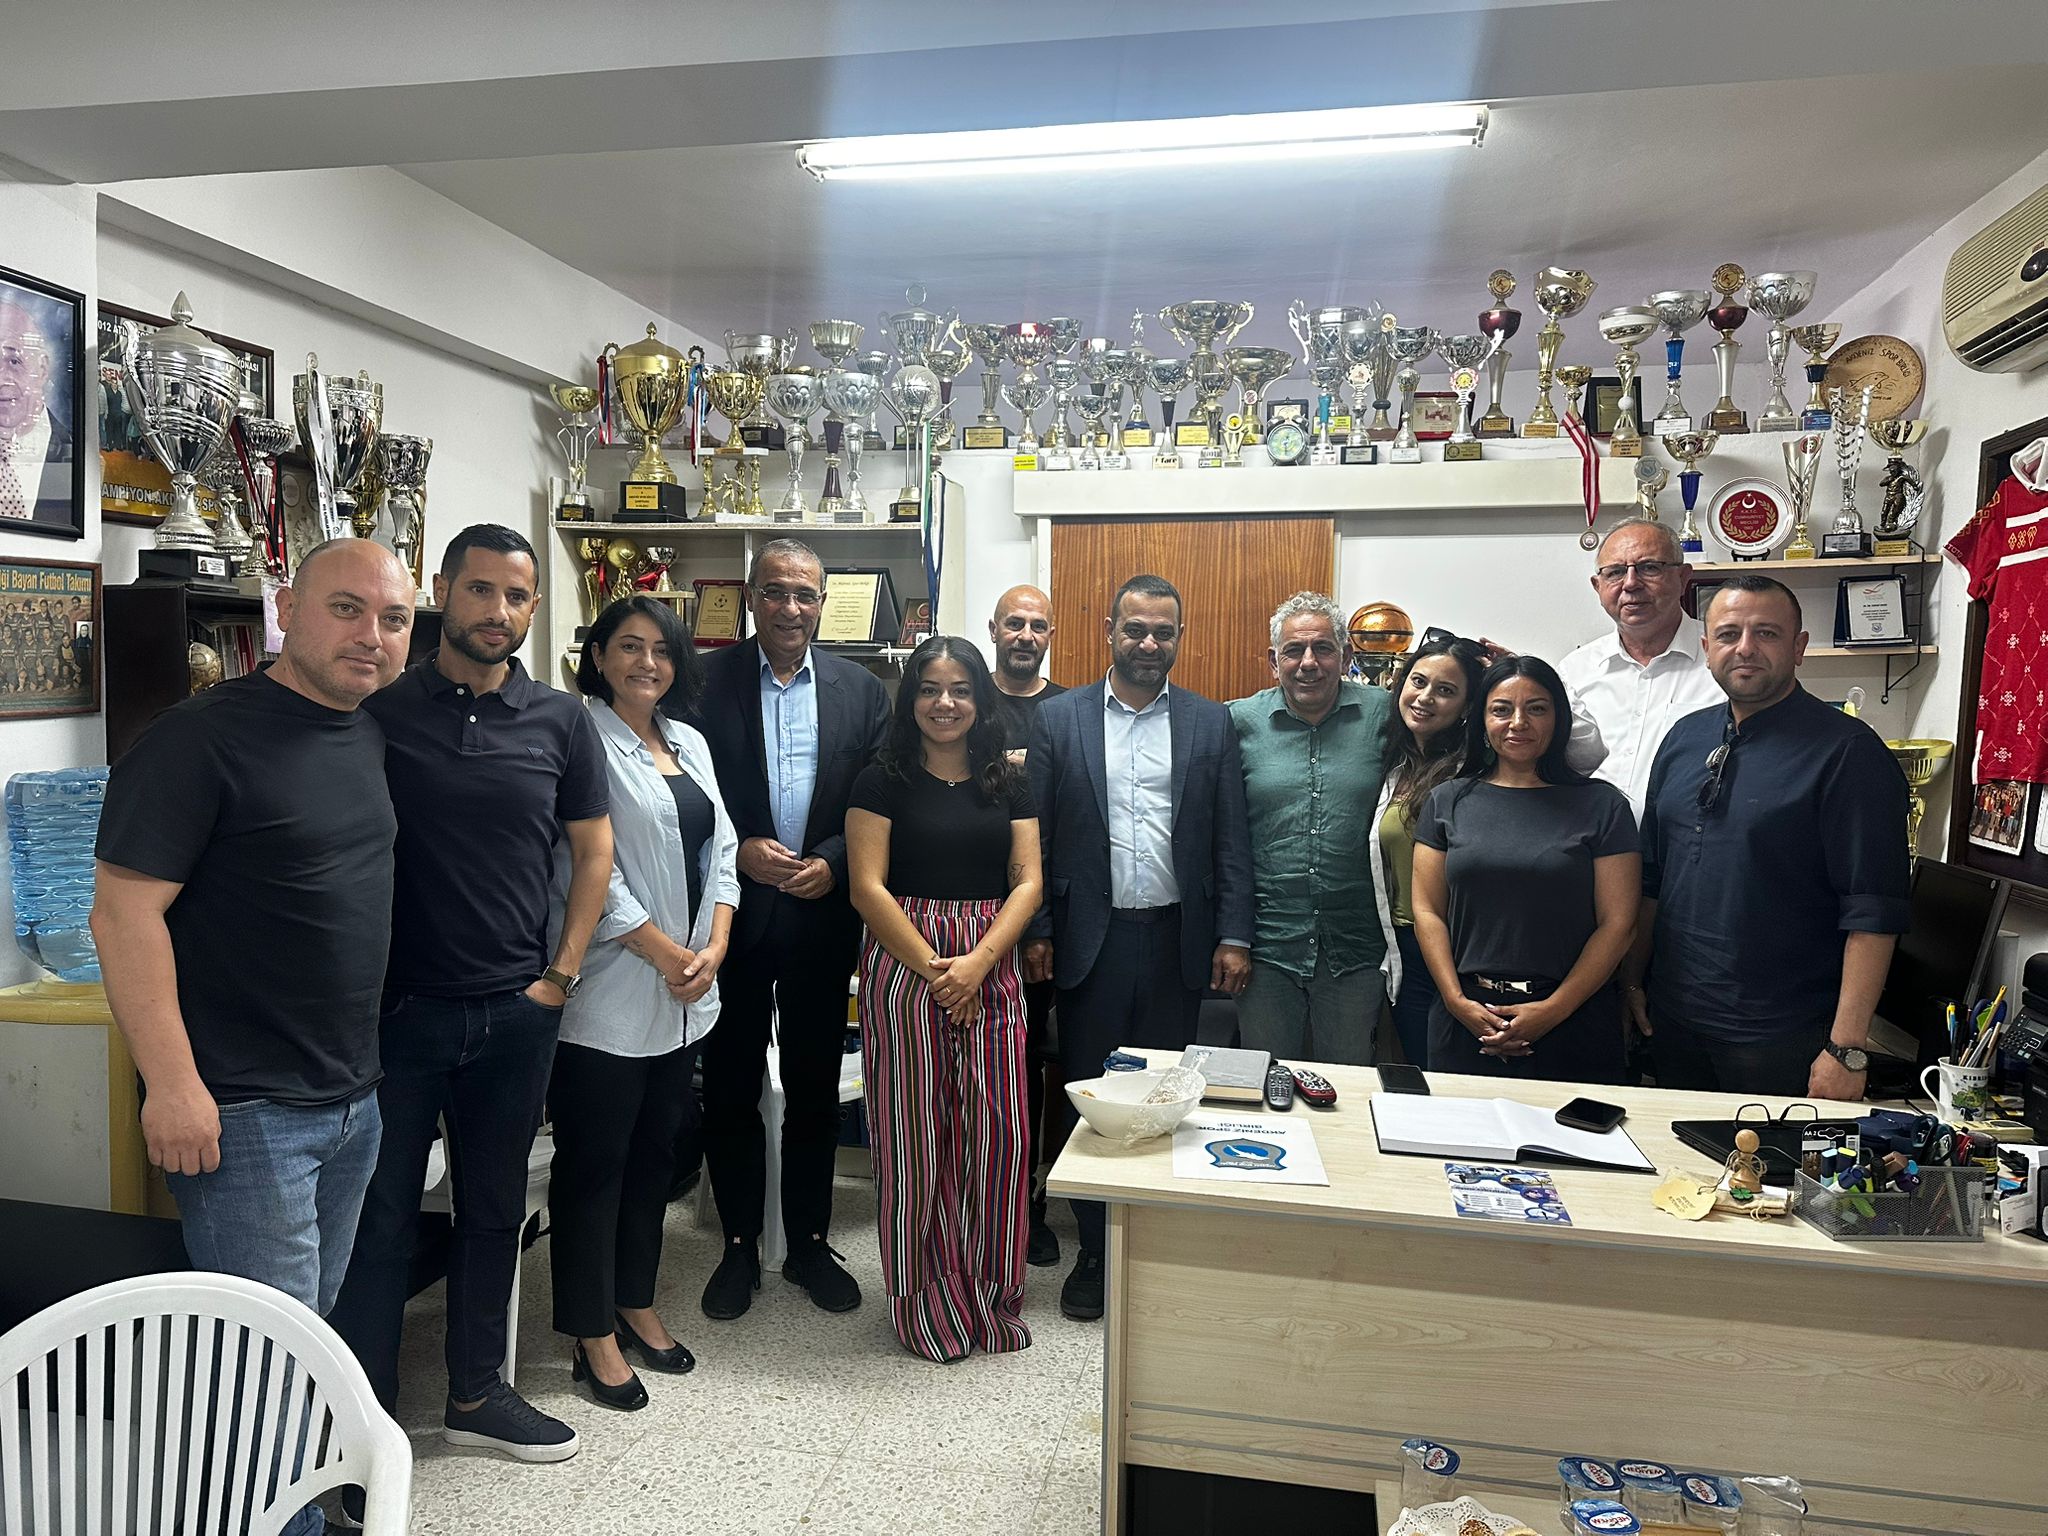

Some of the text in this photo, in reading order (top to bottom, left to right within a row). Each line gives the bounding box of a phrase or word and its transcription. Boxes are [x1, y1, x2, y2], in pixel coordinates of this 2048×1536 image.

[1879, 347, 1899, 362] SPOR
[12, 570, 38, 592] Bayan
[40, 571, 65, 591] Futbol
